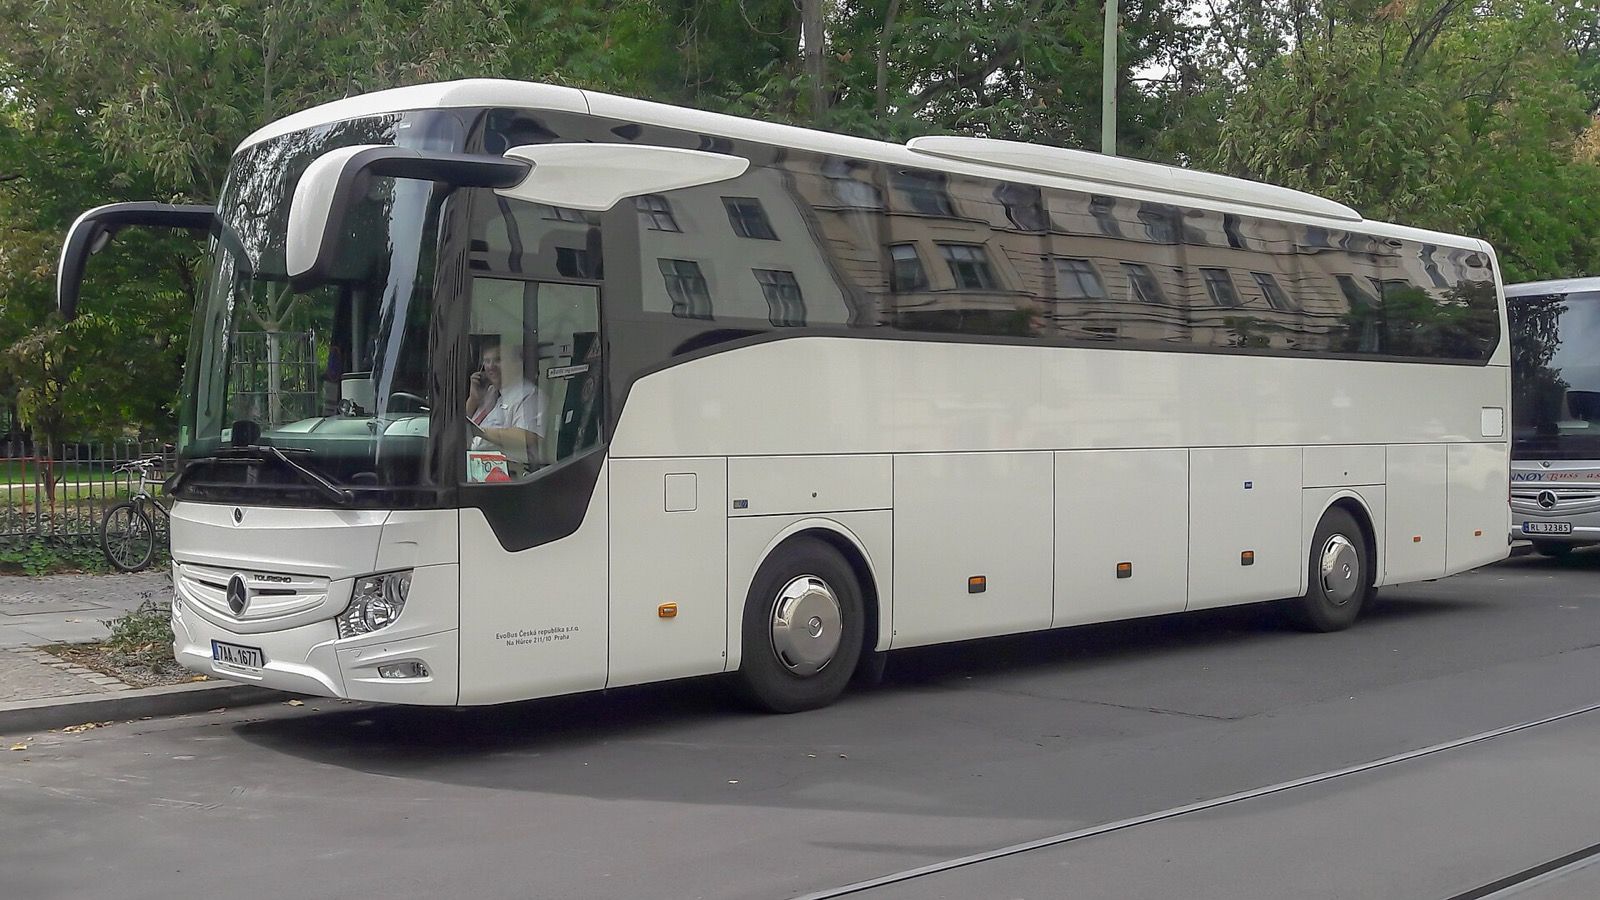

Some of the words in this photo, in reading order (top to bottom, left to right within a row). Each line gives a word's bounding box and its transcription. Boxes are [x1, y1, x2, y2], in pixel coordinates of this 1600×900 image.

[254, 574, 292, 583] TOURISMO
[495, 631, 518, 639] EvoBus
[519, 629, 537, 637] Česká
[537, 627, 565, 636] republika
[554, 633, 570, 641] Praha
[218, 645, 233, 662] 7AA
[238, 649, 256, 667] 1677
